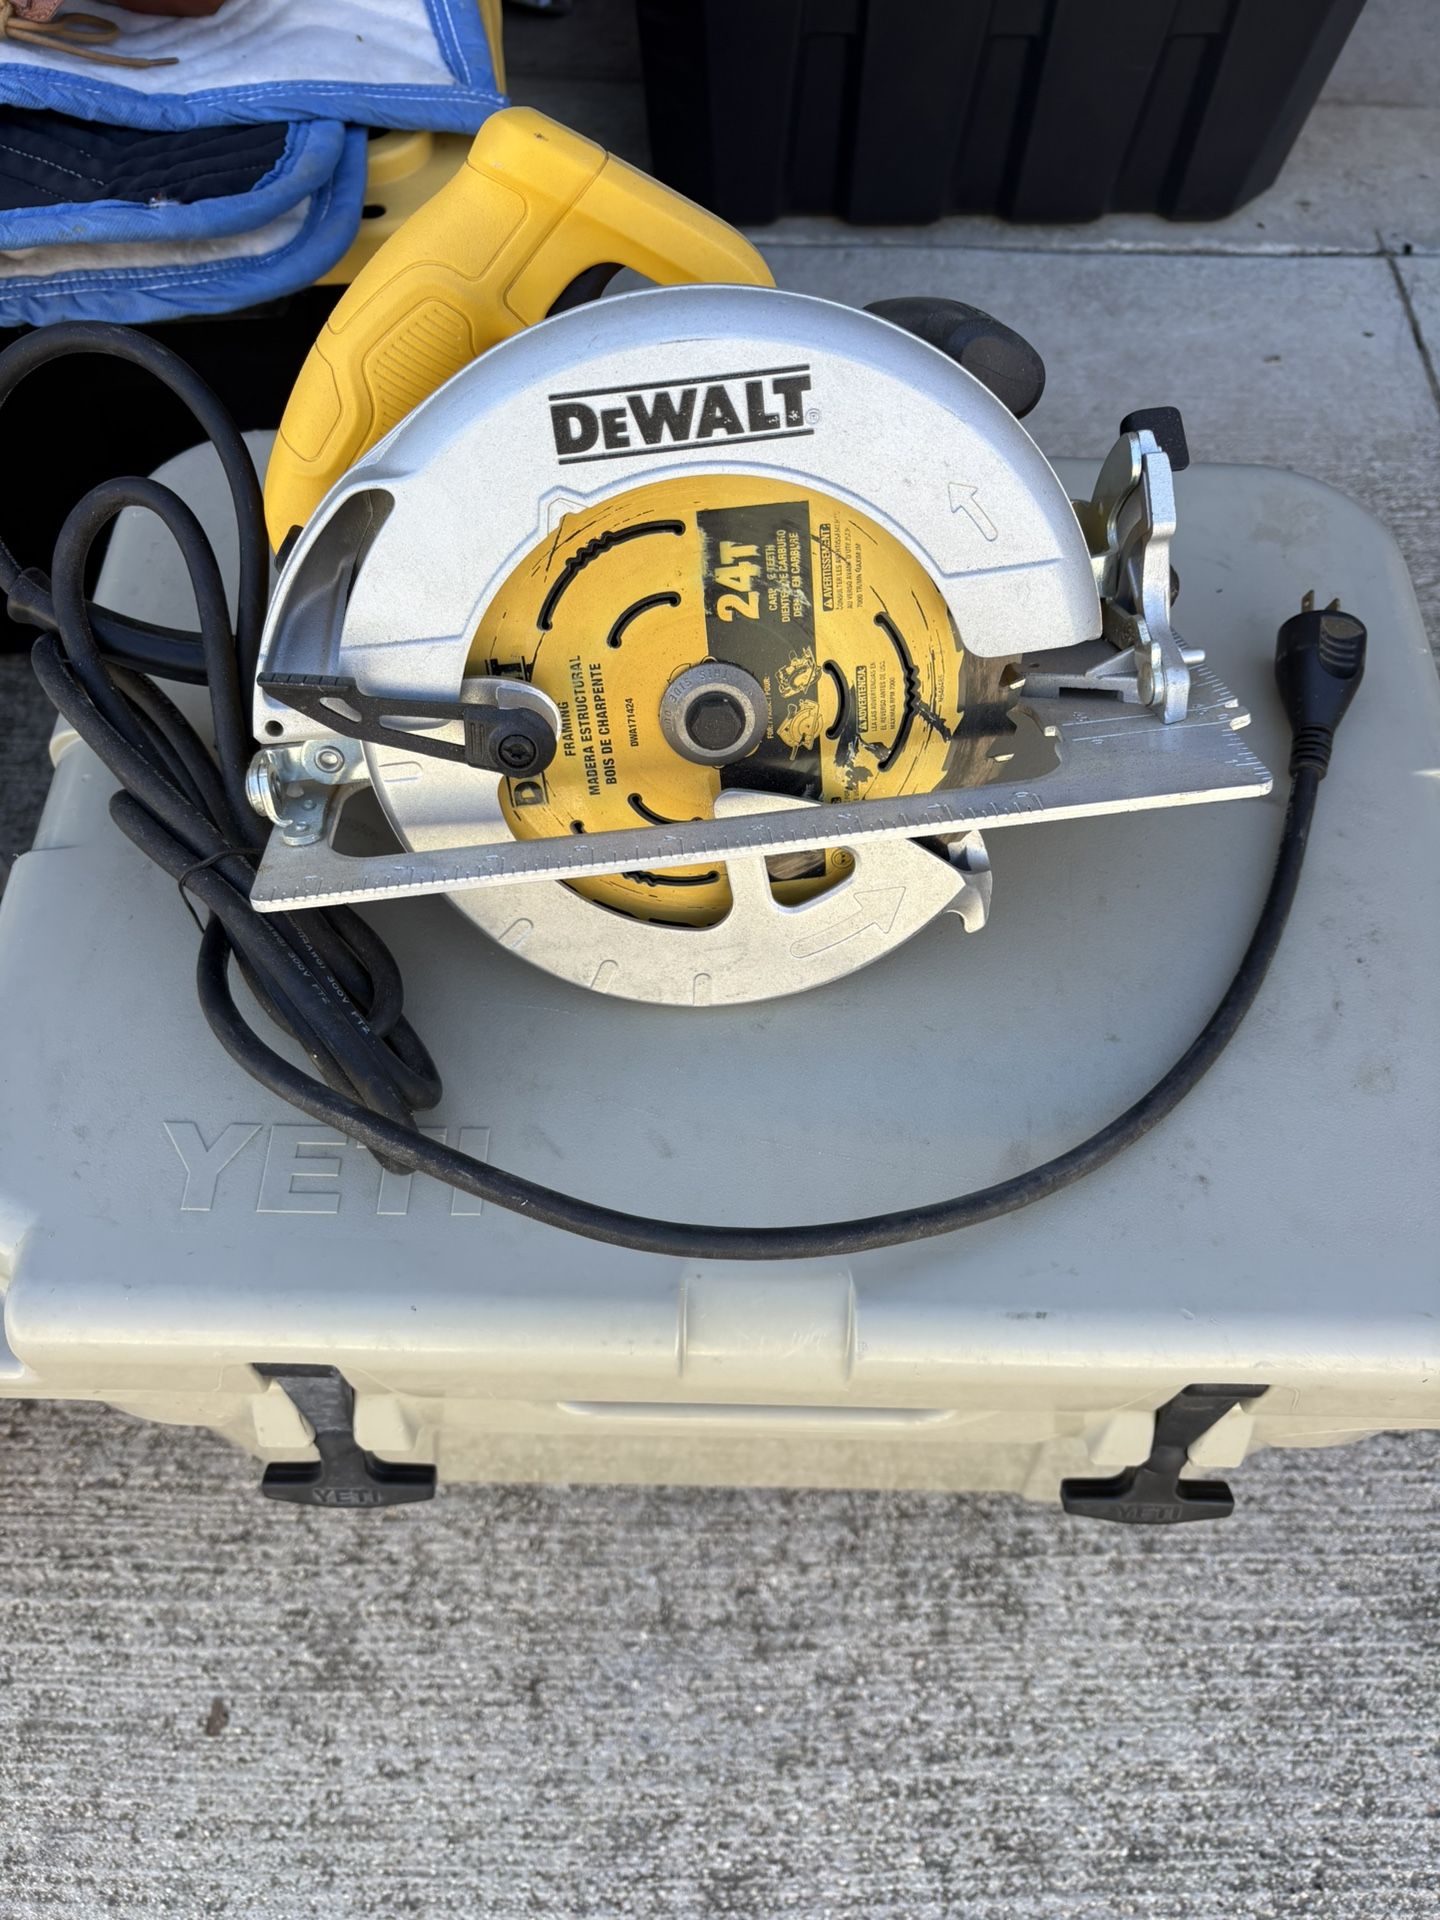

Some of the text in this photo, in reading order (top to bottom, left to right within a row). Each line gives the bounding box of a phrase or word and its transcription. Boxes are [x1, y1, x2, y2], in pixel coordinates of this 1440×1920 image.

[765, 544, 776, 570] TEETH
[776, 530, 788, 571] CARBURO
[714, 541, 762, 622] 24T
[557, 701, 576, 757] FRAMING
[570, 655, 600, 795] MADERA ESTRUCTURAL
[589, 663, 617, 785] BOIS DE CHARPENTE
[625, 698, 639, 747] DWA171424
[327, 975, 350, 1003] 300V
[312, 1488, 381, 1504] YETI
[1115, 1503, 1183, 1519] YETI
